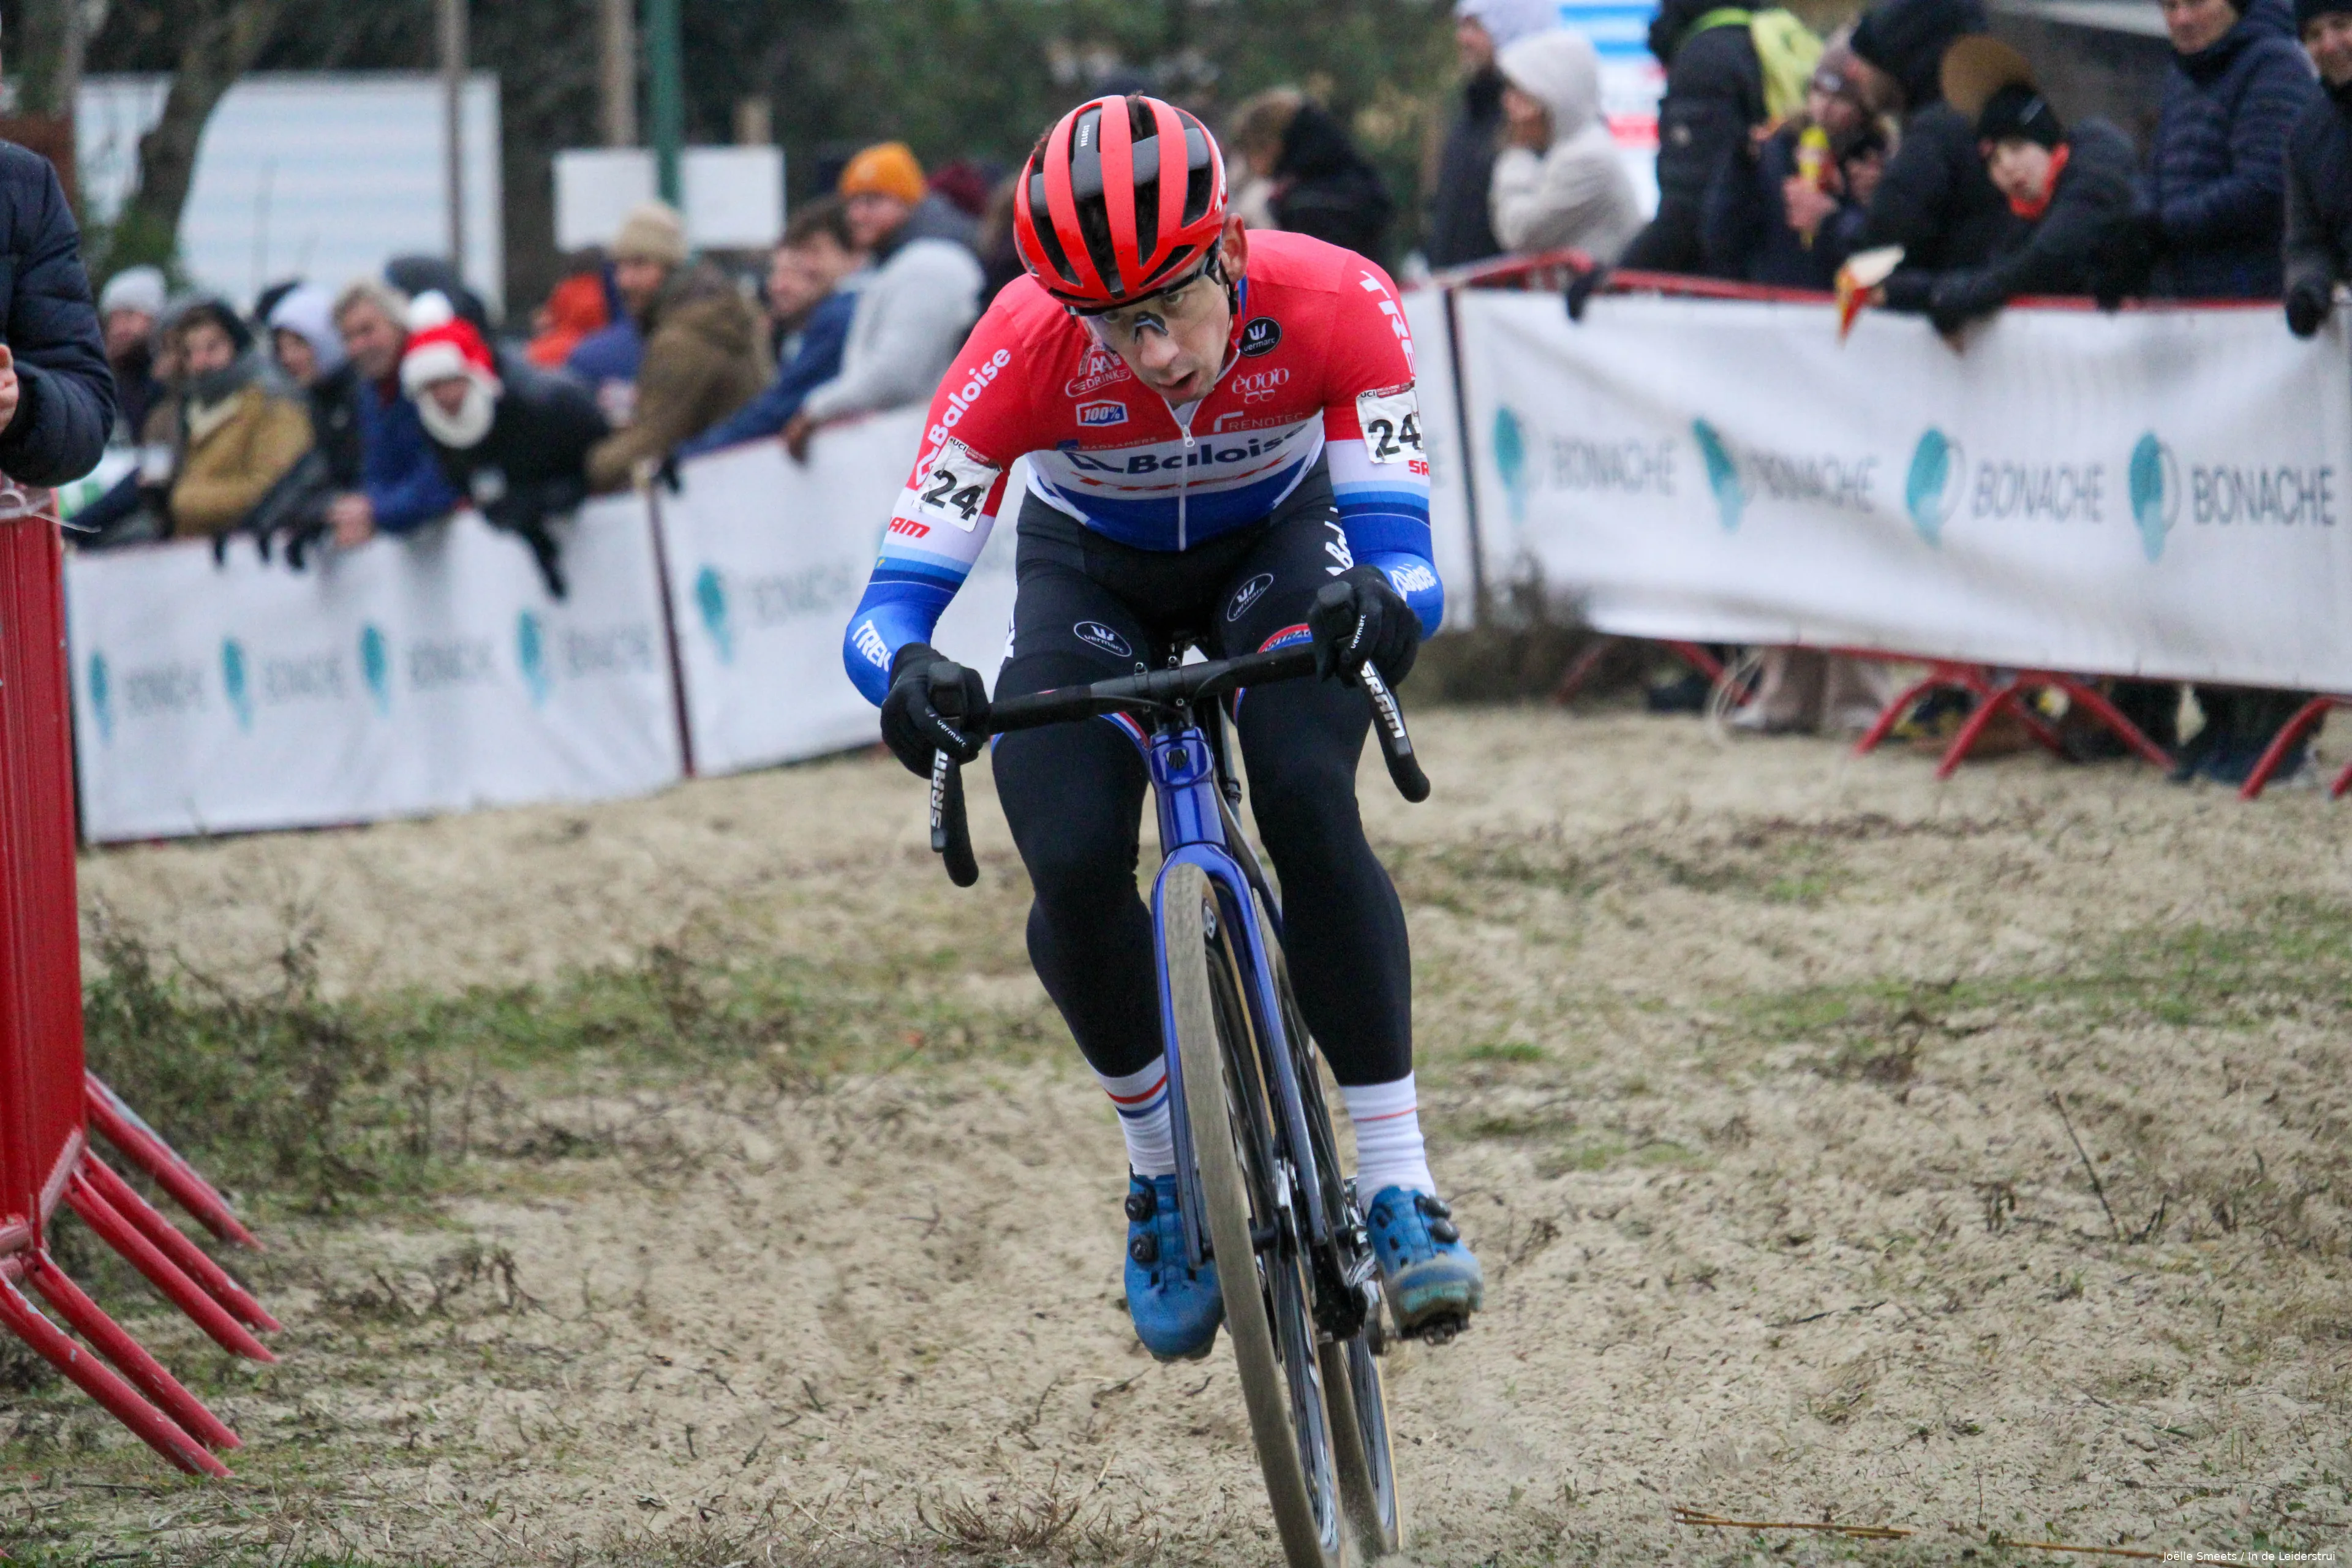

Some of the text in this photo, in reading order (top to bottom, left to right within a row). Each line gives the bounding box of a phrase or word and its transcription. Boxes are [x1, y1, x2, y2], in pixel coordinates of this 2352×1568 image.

[1359, 270, 1416, 380] TRE
[1243, 337, 1275, 352] vermarc
[1085, 371, 1120, 389] DRINK
[1090, 355, 1113, 377] AA
[928, 349, 1011, 447] Baloise
[1084, 405, 1120, 422] 100%
[1228, 412, 1303, 430] RENOTEC
[952, 439, 967, 451] UCI
[1082, 437, 1157, 450] BADKAMERS
[1368, 413, 1422, 458] 24
[1408, 460, 1430, 476] SR
[920, 469, 986, 521] 24
[1970, 459, 2105, 525] BONACHE
[2192, 463, 2336, 526] BONACHE
[888, 516, 930, 539] AM
[852, 620, 892, 673] TREK
[1084, 633, 1124, 654] vermarc
[1351, 614, 1366, 649] vermarc
[1360, 661, 1406, 739] SRAM
[937, 718, 967, 748] vermarc
[931, 748, 948, 829] SRAM
